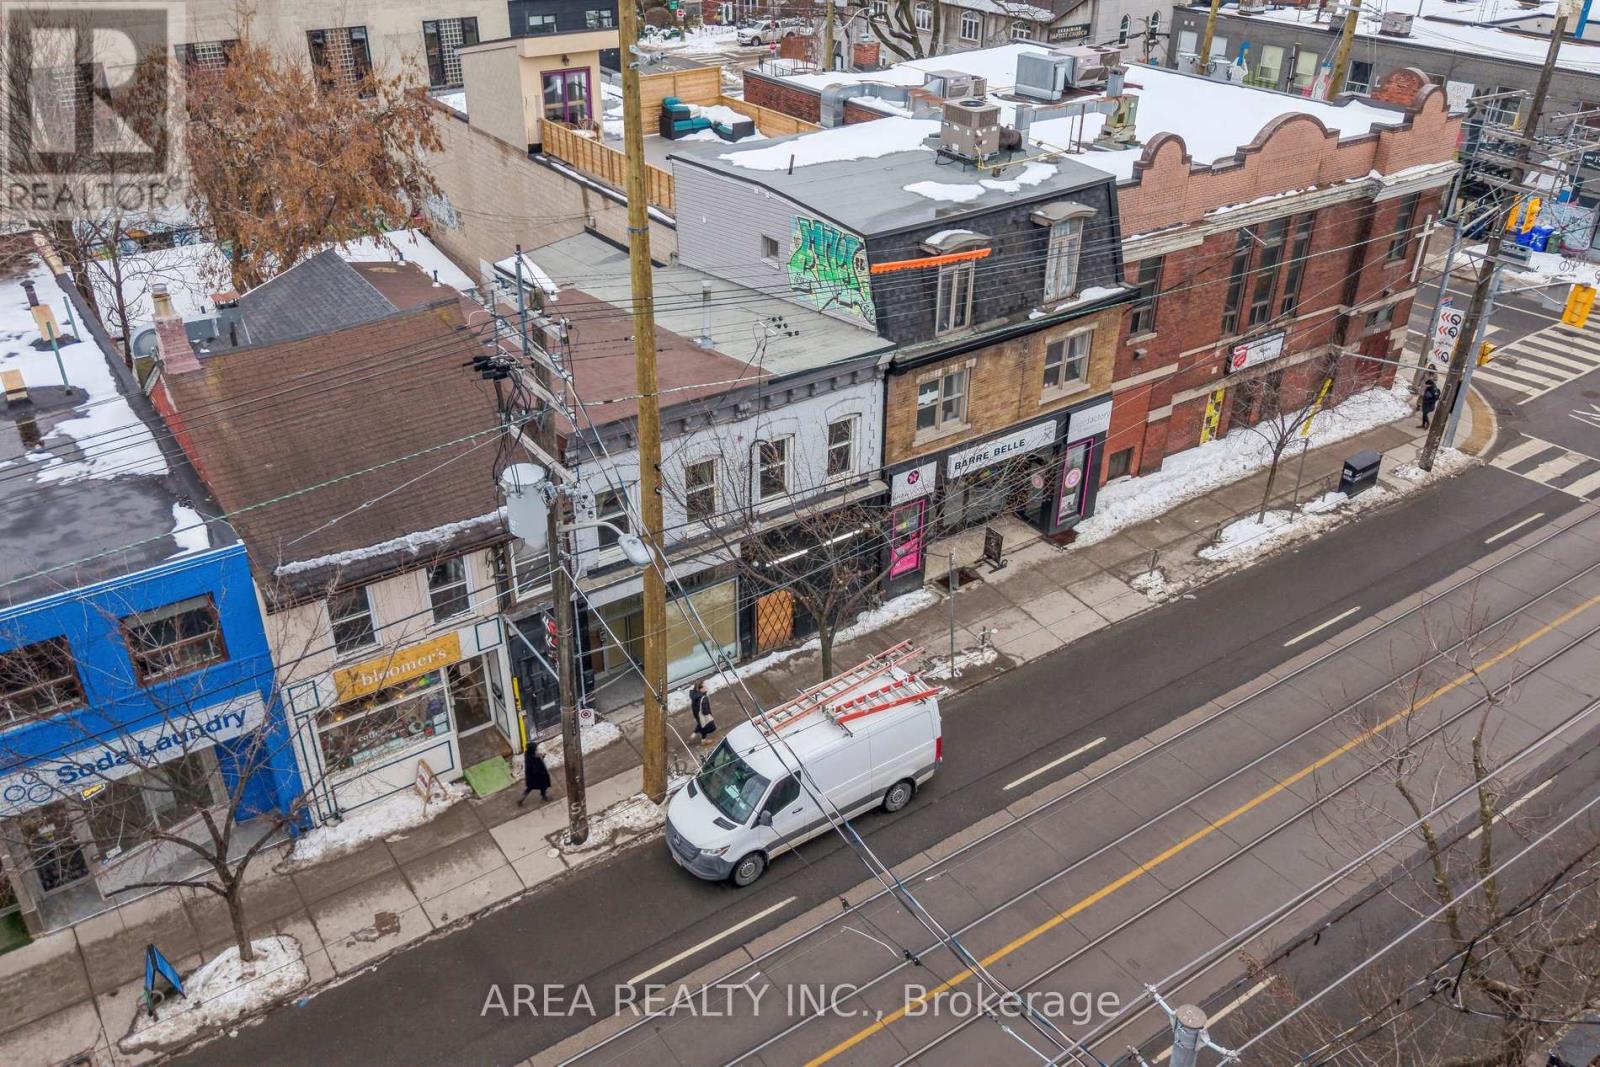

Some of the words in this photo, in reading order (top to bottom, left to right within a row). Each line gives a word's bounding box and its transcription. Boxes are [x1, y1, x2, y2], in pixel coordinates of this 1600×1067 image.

[954, 451, 990, 470] BARRE
[993, 438, 1026, 456] BELLE
[360, 647, 447, 687] bloomer's
[56, 751, 129, 784] Soda
[138, 709, 247, 757] Laundry
